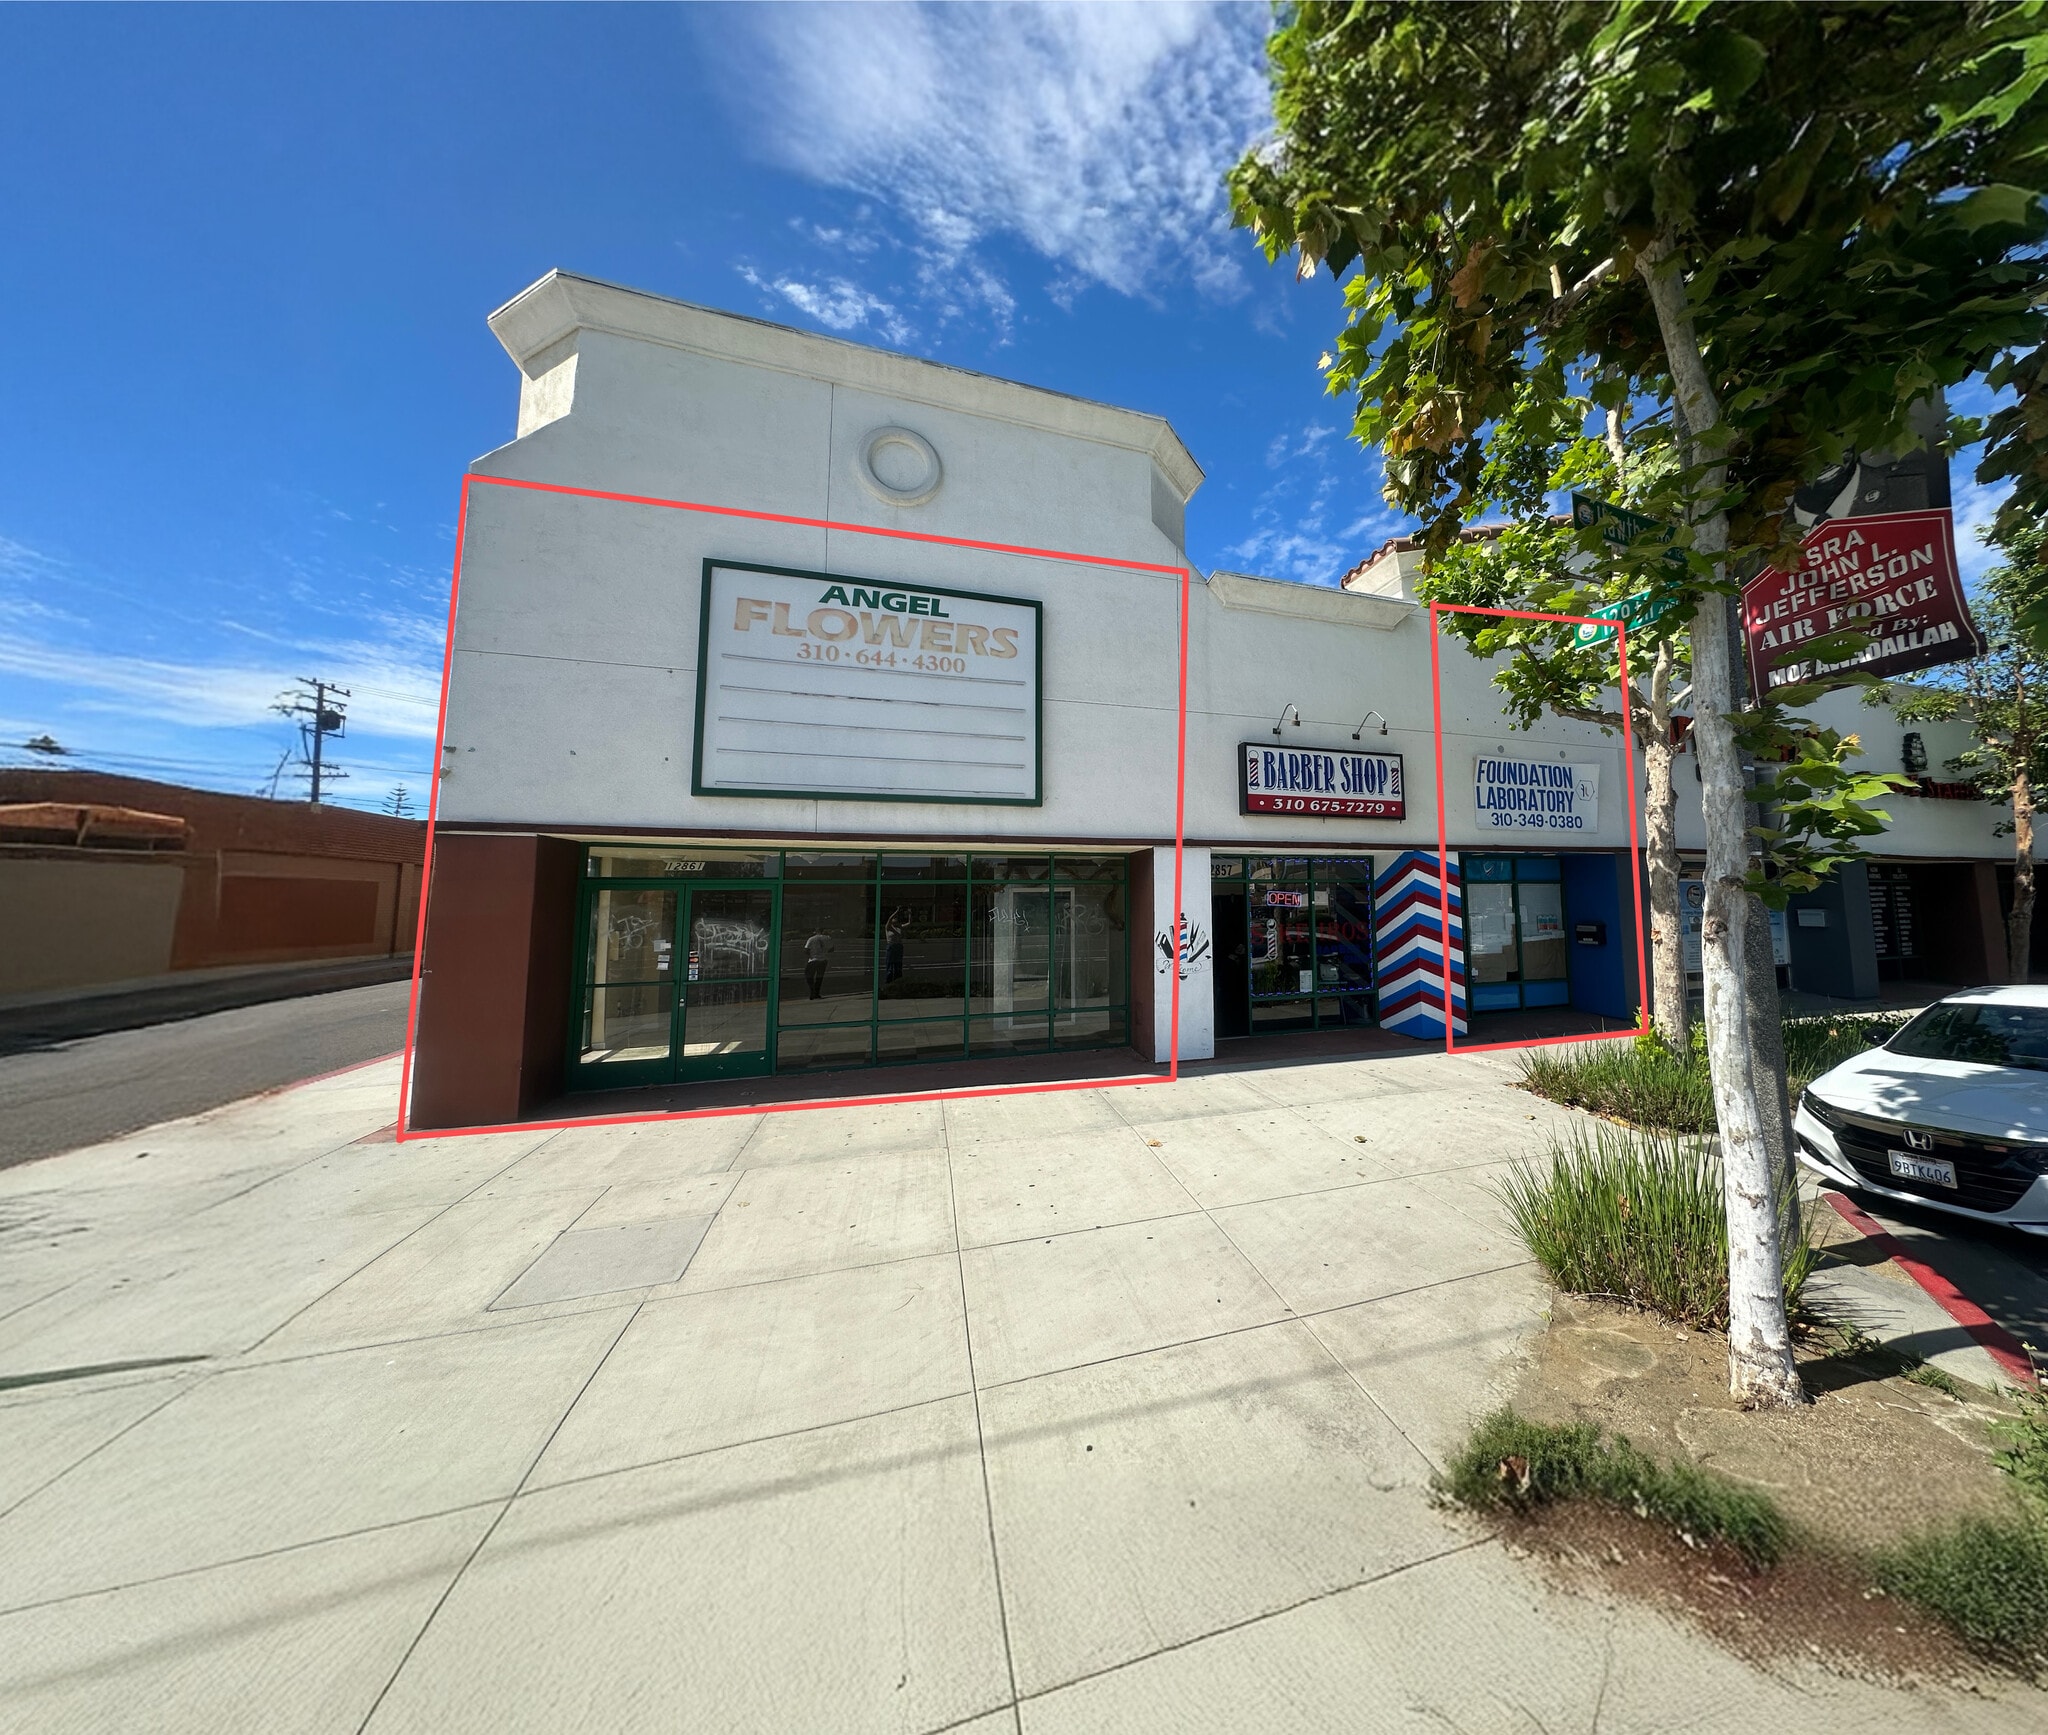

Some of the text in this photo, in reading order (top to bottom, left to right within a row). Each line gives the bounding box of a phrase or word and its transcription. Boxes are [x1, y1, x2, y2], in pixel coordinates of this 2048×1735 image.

[1806, 529, 1865, 567] SRA
[1755, 543, 1934, 625] JEFFERSON
[1779, 542, 1898, 596] JOHN L.
[818, 585, 950, 618] ANGEL
[1759, 618, 1816, 652] AIR
[1826, 575, 1938, 629] FORCE
[733, 596, 1019, 660] FLOWERS
[1893, 614, 1928, 632] By:
[1263, 750, 1388, 796] BARBER SHOP
[1476, 759, 1573, 789] FOUNDATION
[1272, 798, 1385, 814] 310 675-7279
[1476, 785, 1574, 813] LABORATORY
[1491, 812, 1583, 829] 310-349-0380
[667, 861, 704, 871] 12861
[1268, 892, 1301, 906] OPEN
[1894, 1160, 1952, 1183] 9BTK406
